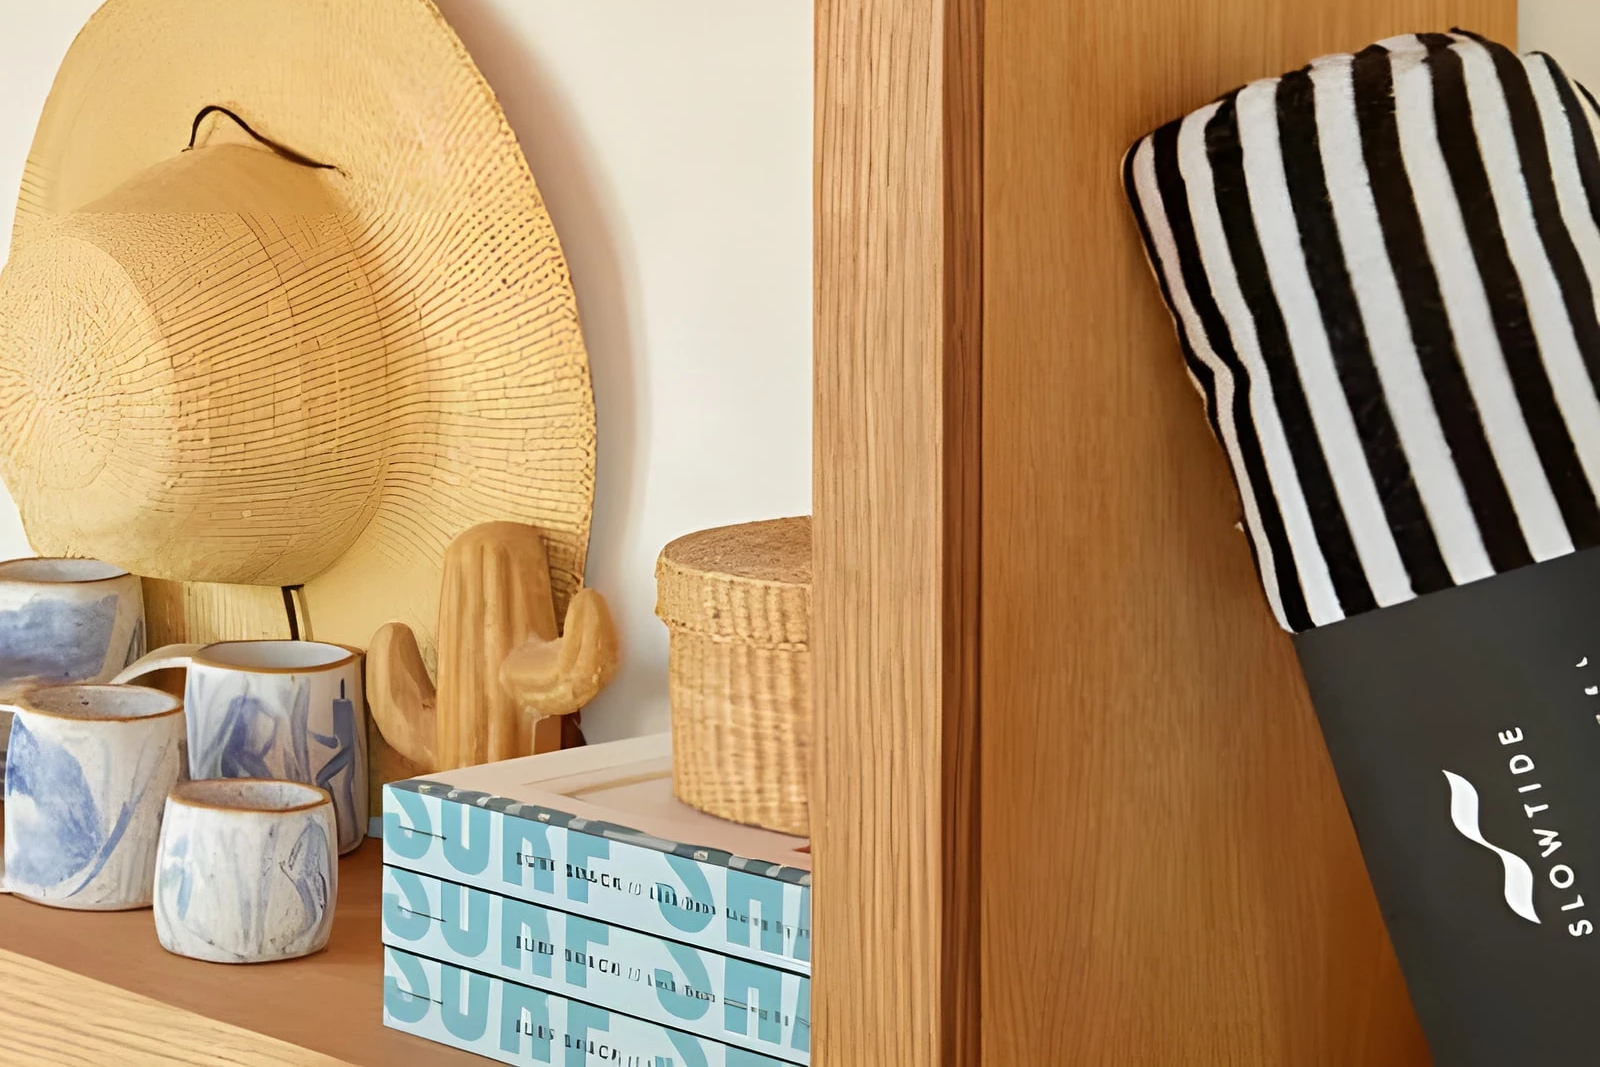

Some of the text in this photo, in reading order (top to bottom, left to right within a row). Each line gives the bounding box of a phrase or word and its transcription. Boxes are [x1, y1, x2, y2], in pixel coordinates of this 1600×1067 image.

[384, 786, 610, 905] SURF
[1498, 726, 1595, 937] SLOWTIDE
[384, 868, 610, 989] SURF
[384, 947, 610, 1067] SURF
